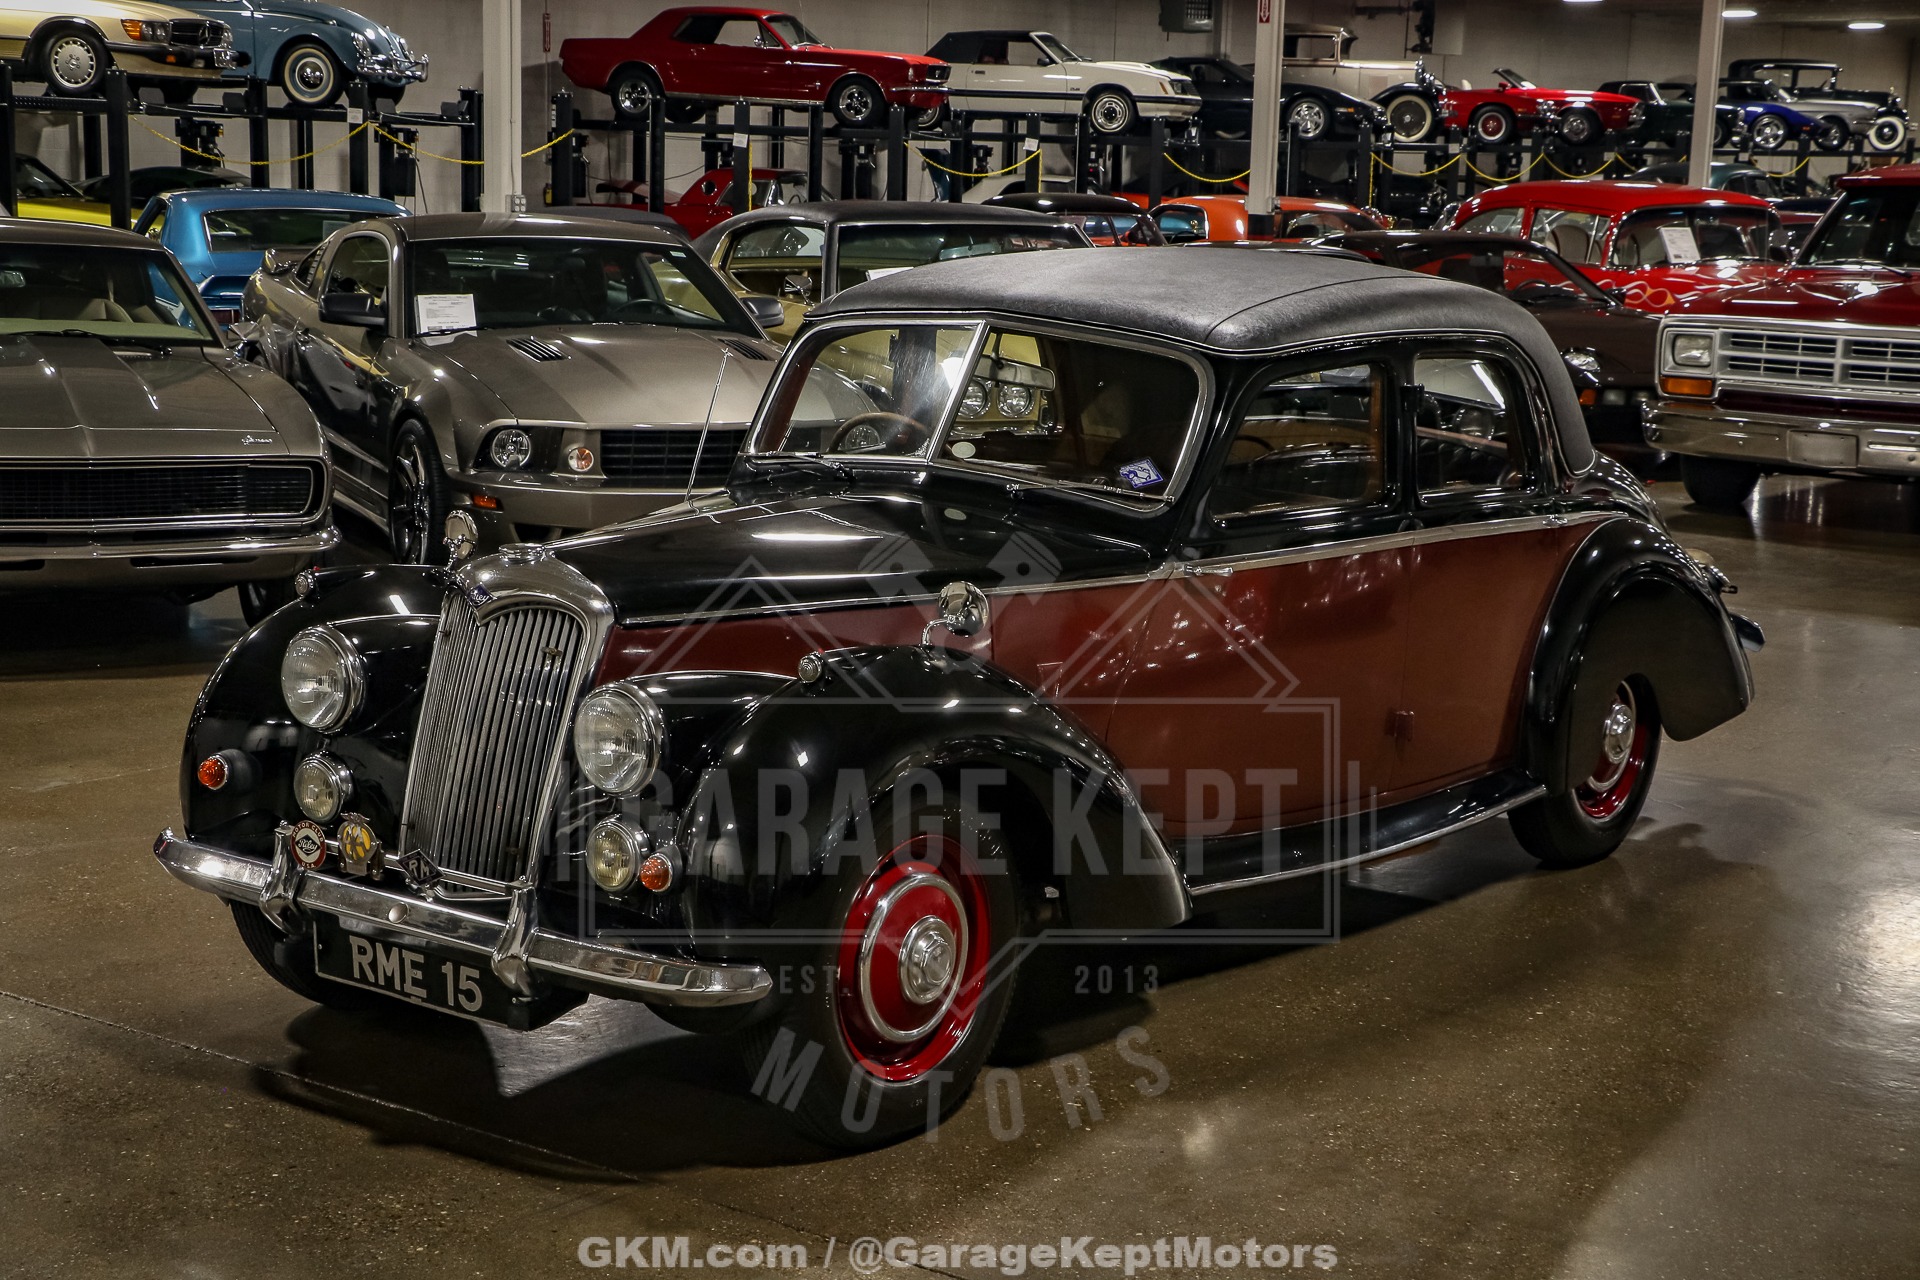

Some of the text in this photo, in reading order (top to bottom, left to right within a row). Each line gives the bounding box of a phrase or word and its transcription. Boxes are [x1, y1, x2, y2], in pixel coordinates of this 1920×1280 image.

[292, 822, 325, 842] MOTOR CLUB
[298, 838, 318, 854] Riley
[408, 859, 430, 879] RM
[349, 935, 483, 1012] RME 15
